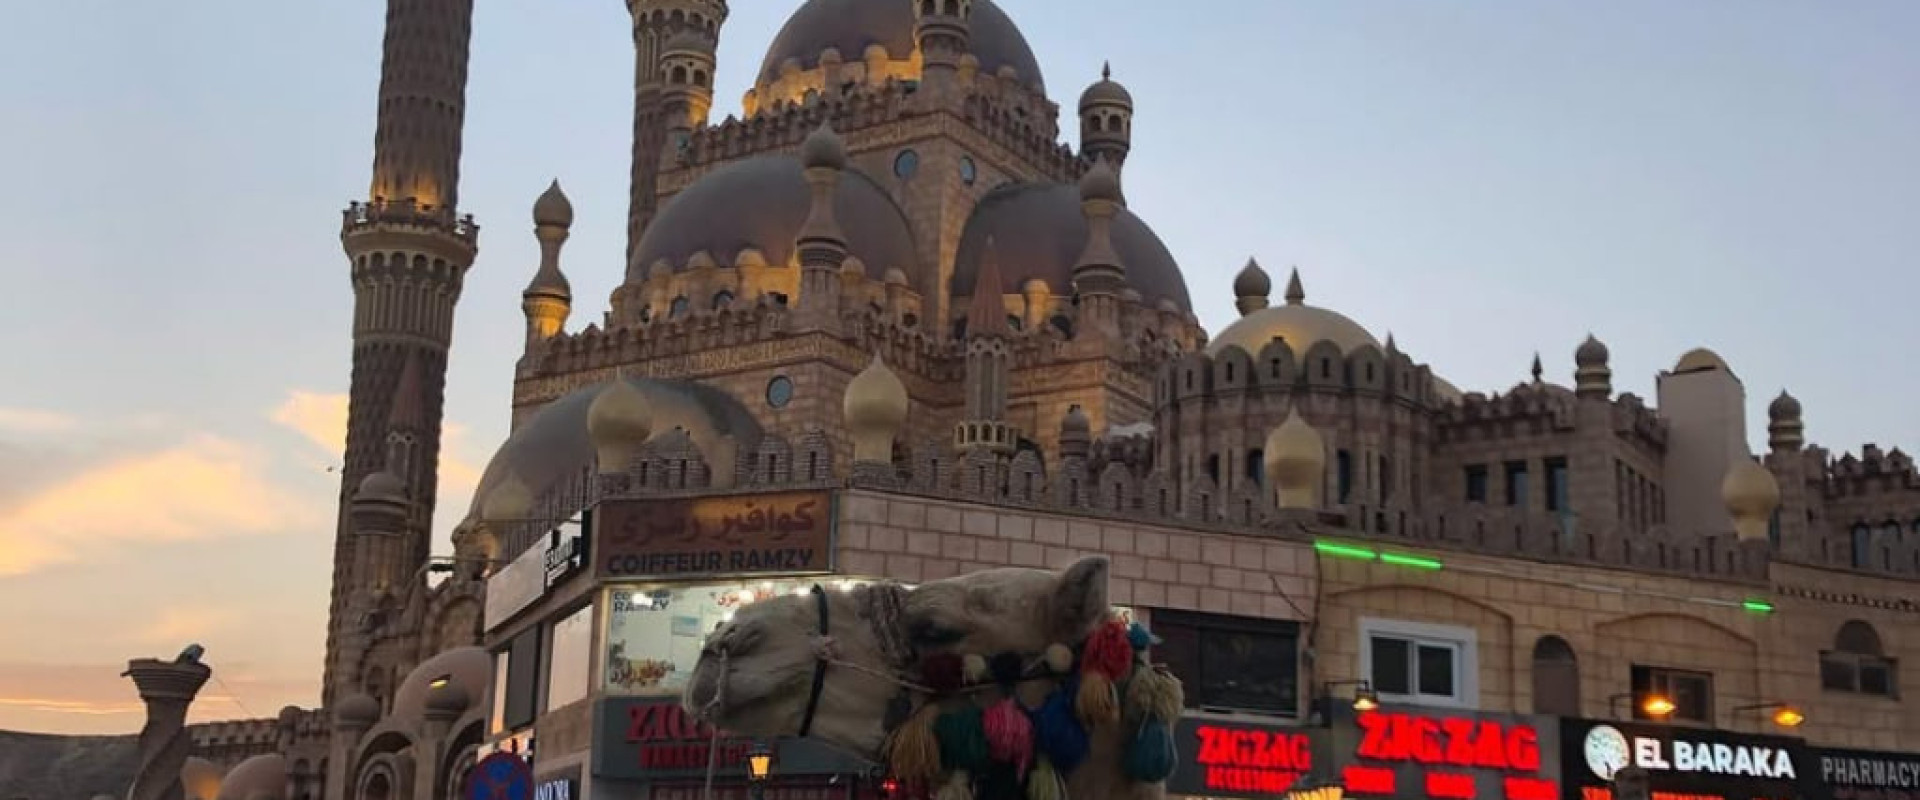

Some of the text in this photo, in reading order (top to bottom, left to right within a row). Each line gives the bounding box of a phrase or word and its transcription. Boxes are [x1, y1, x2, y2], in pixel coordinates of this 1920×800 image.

[607, 549, 813, 574] COIFFEUR RAMZY
[1196, 726, 1311, 771] ZIGZAG
[1357, 711, 1540, 772] ZIGZAG
[1634, 736, 1796, 779] EL BARAKA
[1821, 756, 1919, 788] PHARMACY
